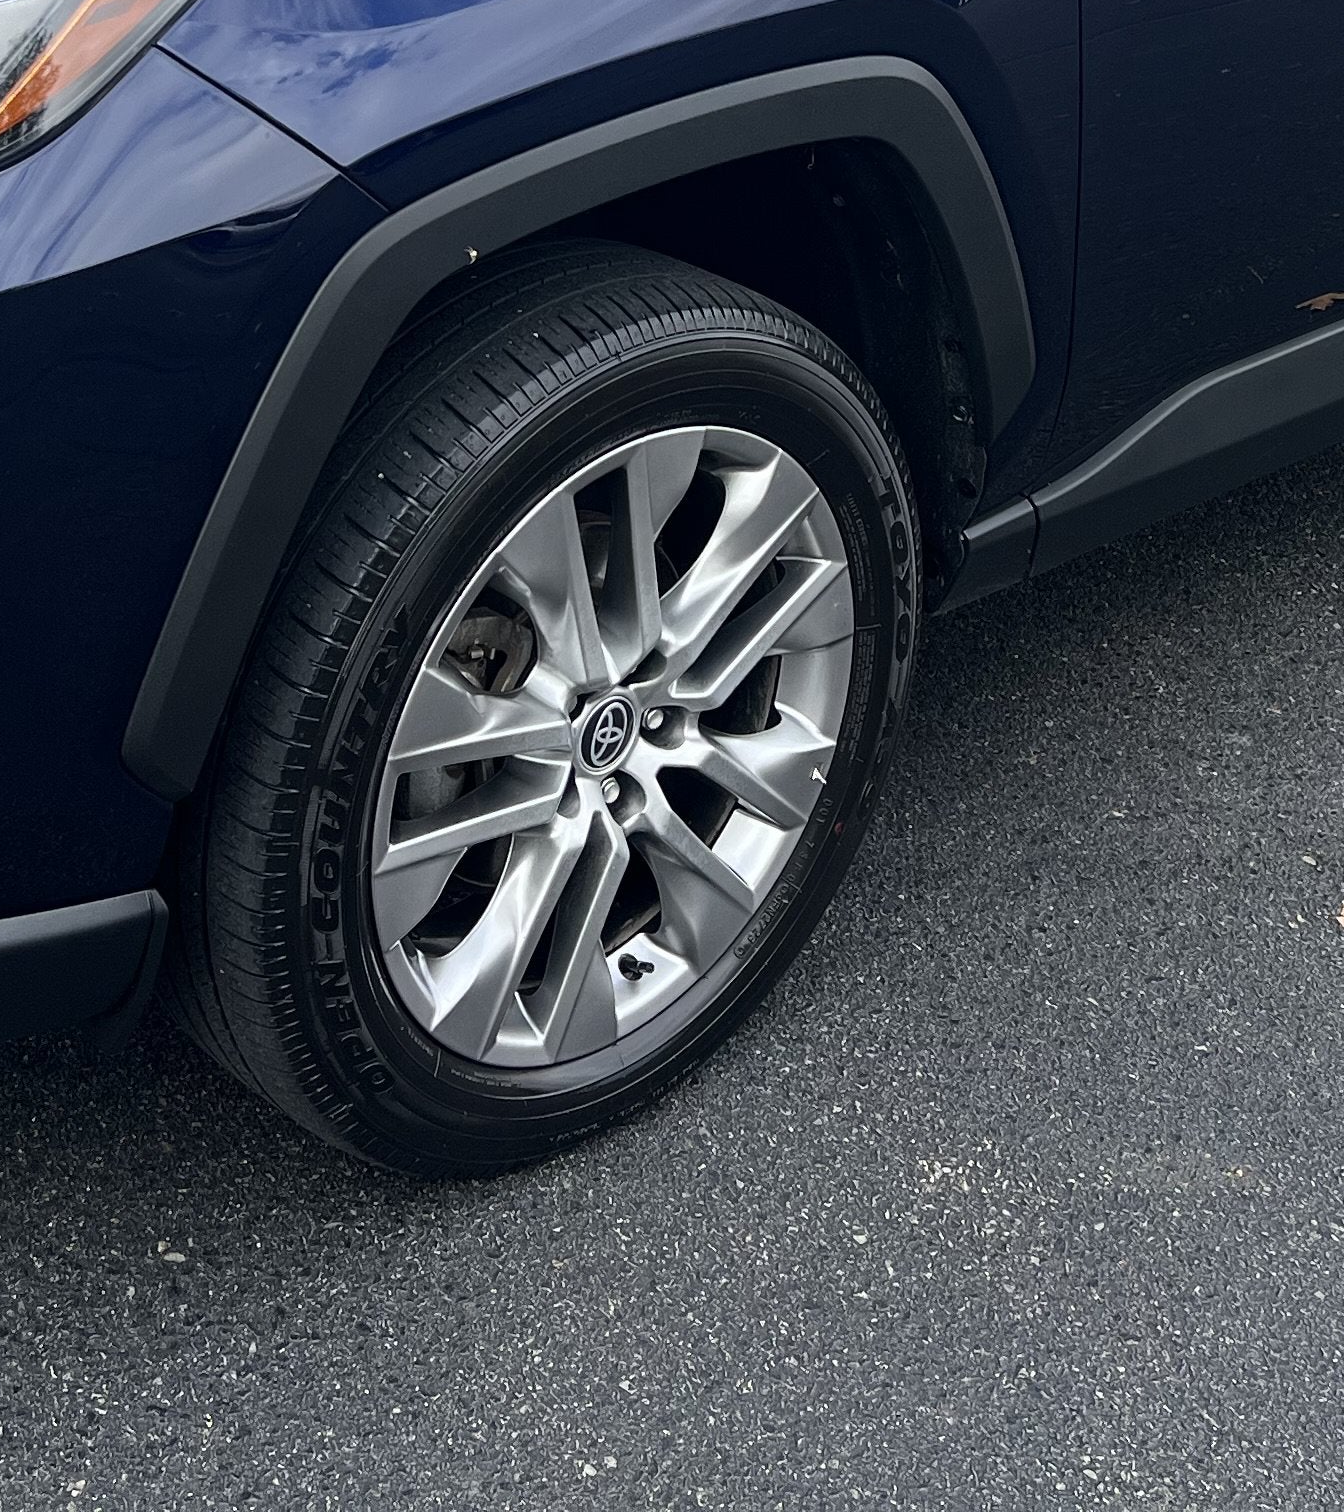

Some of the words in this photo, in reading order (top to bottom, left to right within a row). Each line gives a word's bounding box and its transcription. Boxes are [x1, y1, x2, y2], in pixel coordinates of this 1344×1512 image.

[876, 476, 912, 664] TOYO
[312, 602, 410, 934] COUNTRY
[317, 960, 397, 1097] OPEN
